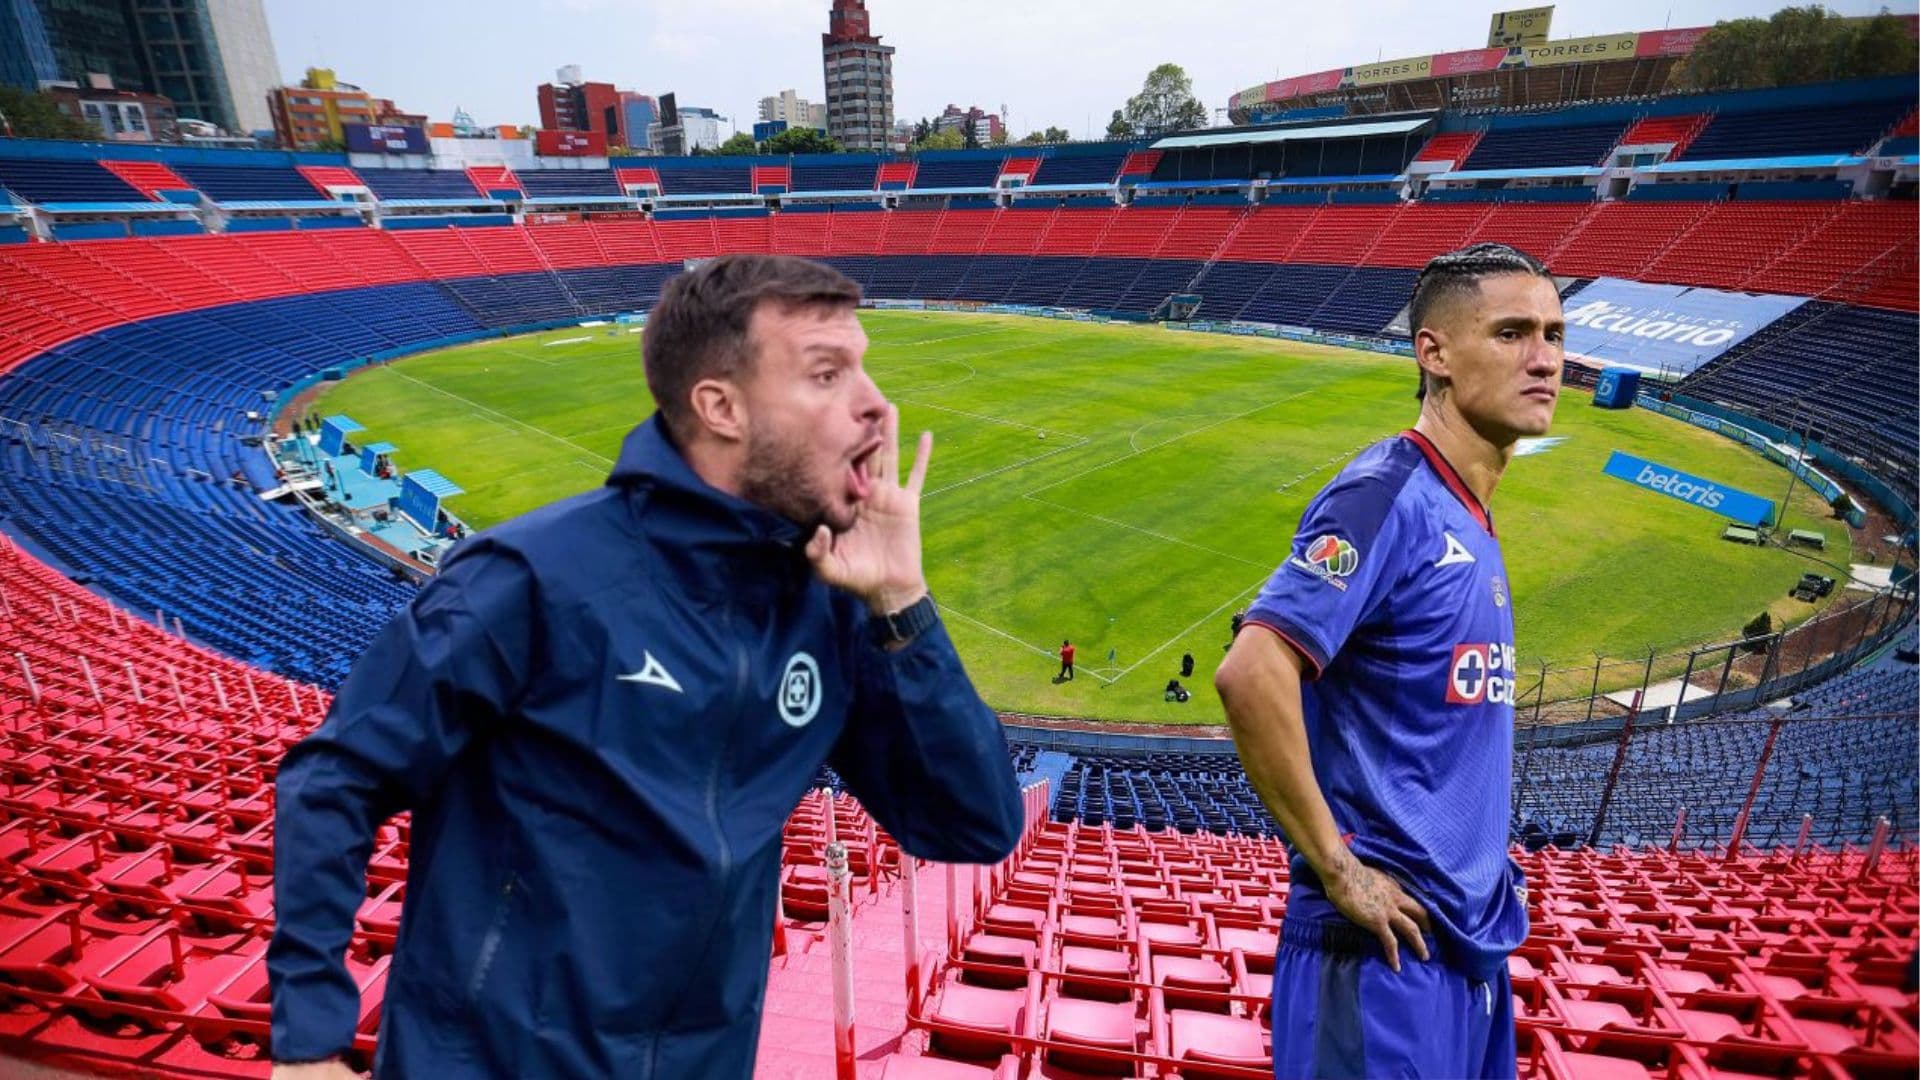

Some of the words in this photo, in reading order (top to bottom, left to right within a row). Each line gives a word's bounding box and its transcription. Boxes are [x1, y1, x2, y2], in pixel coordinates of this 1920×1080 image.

[1528, 43, 1607, 58] TORRES
[1616, 40, 1634, 51] 10
[1355, 64, 1411, 80] TORRES
[1565, 300, 1736, 346] Acuario
[1636, 465, 1725, 508] betcris
